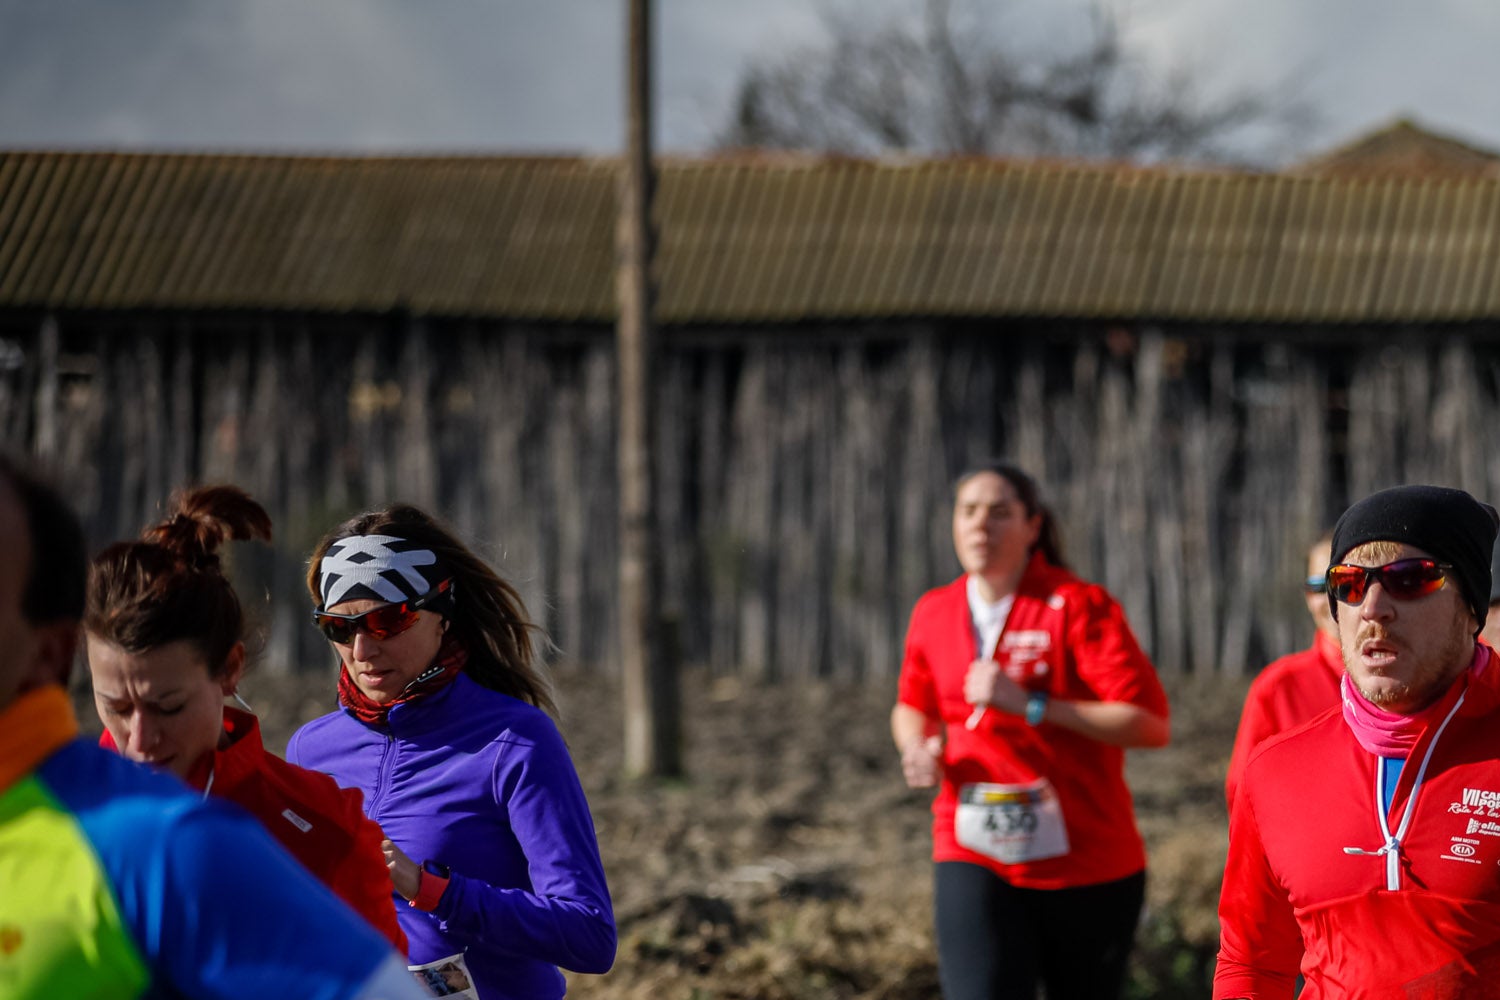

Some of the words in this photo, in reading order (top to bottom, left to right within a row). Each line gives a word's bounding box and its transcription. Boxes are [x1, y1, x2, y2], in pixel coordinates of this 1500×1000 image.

[1462, 788, 1480, 806] VII
[1473, 806, 1485, 816] de
[1454, 846, 1472, 855] KIA
